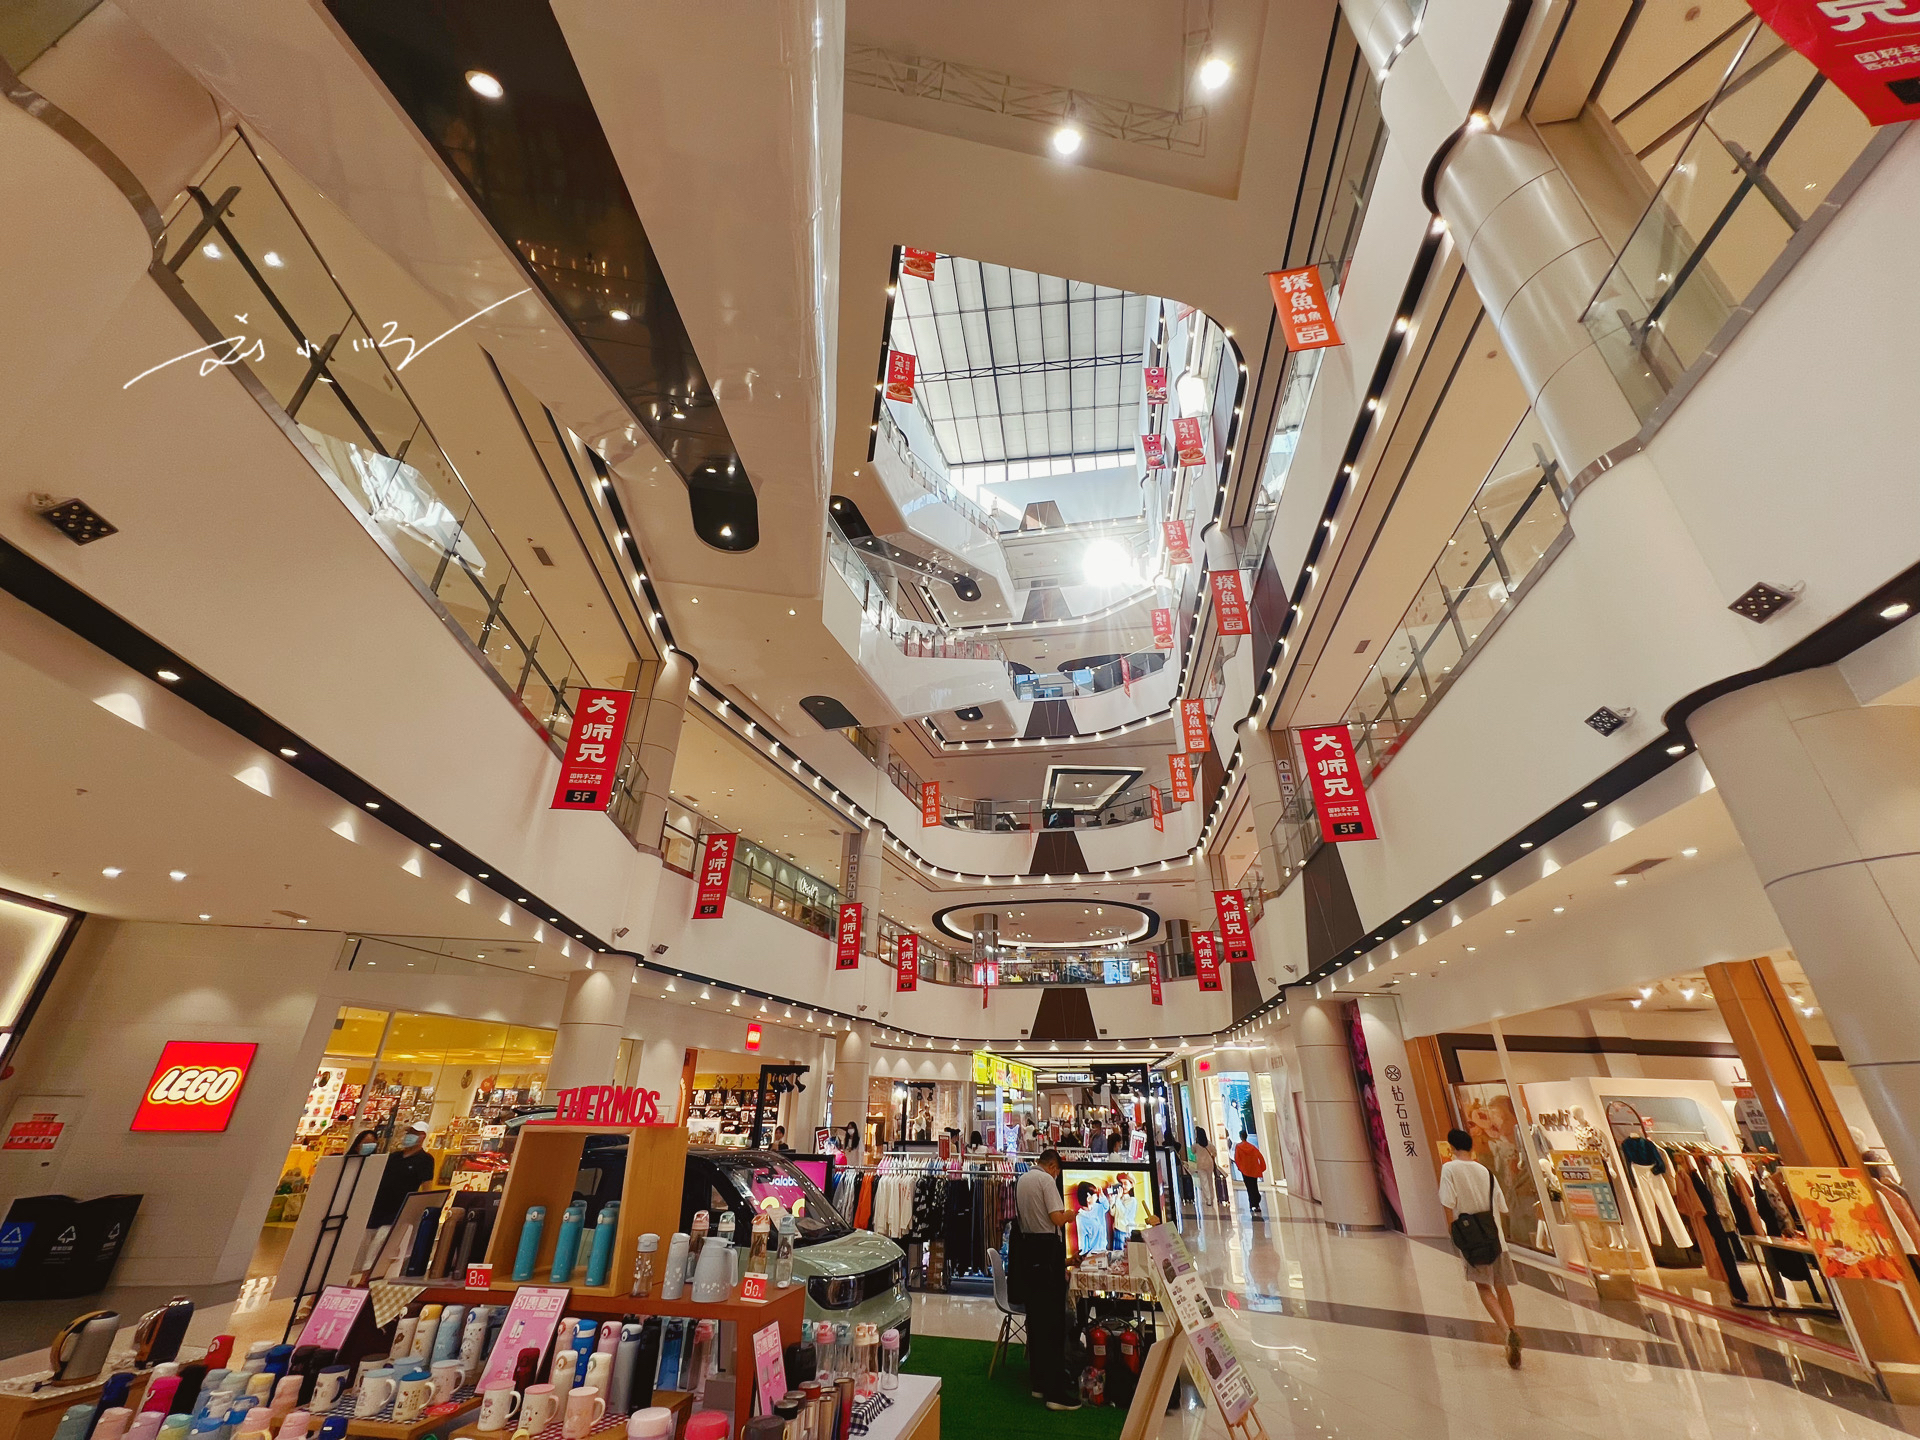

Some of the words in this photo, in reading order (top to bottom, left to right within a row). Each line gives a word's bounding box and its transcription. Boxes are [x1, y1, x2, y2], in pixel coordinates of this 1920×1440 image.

[1302, 331, 1324, 341] 5F
[576, 696, 617, 763] 大师兄
[1313, 733, 1354, 797] 大师兄
[573, 791, 590, 801] 5F
[1340, 824, 1356, 833] 5F
[705, 839, 728, 886] 大师兄
[843, 907, 857, 944] 大师兄
[1221, 894, 1243, 935] 大师兄
[902, 938, 913, 970] 大师兄
[1197, 935, 1214, 968] 大师兄
[150, 1068, 240, 1103] LEGO
[556, 1085, 660, 1123] THERMOS
[1391, 1085, 1418, 1157] 钻石世家
